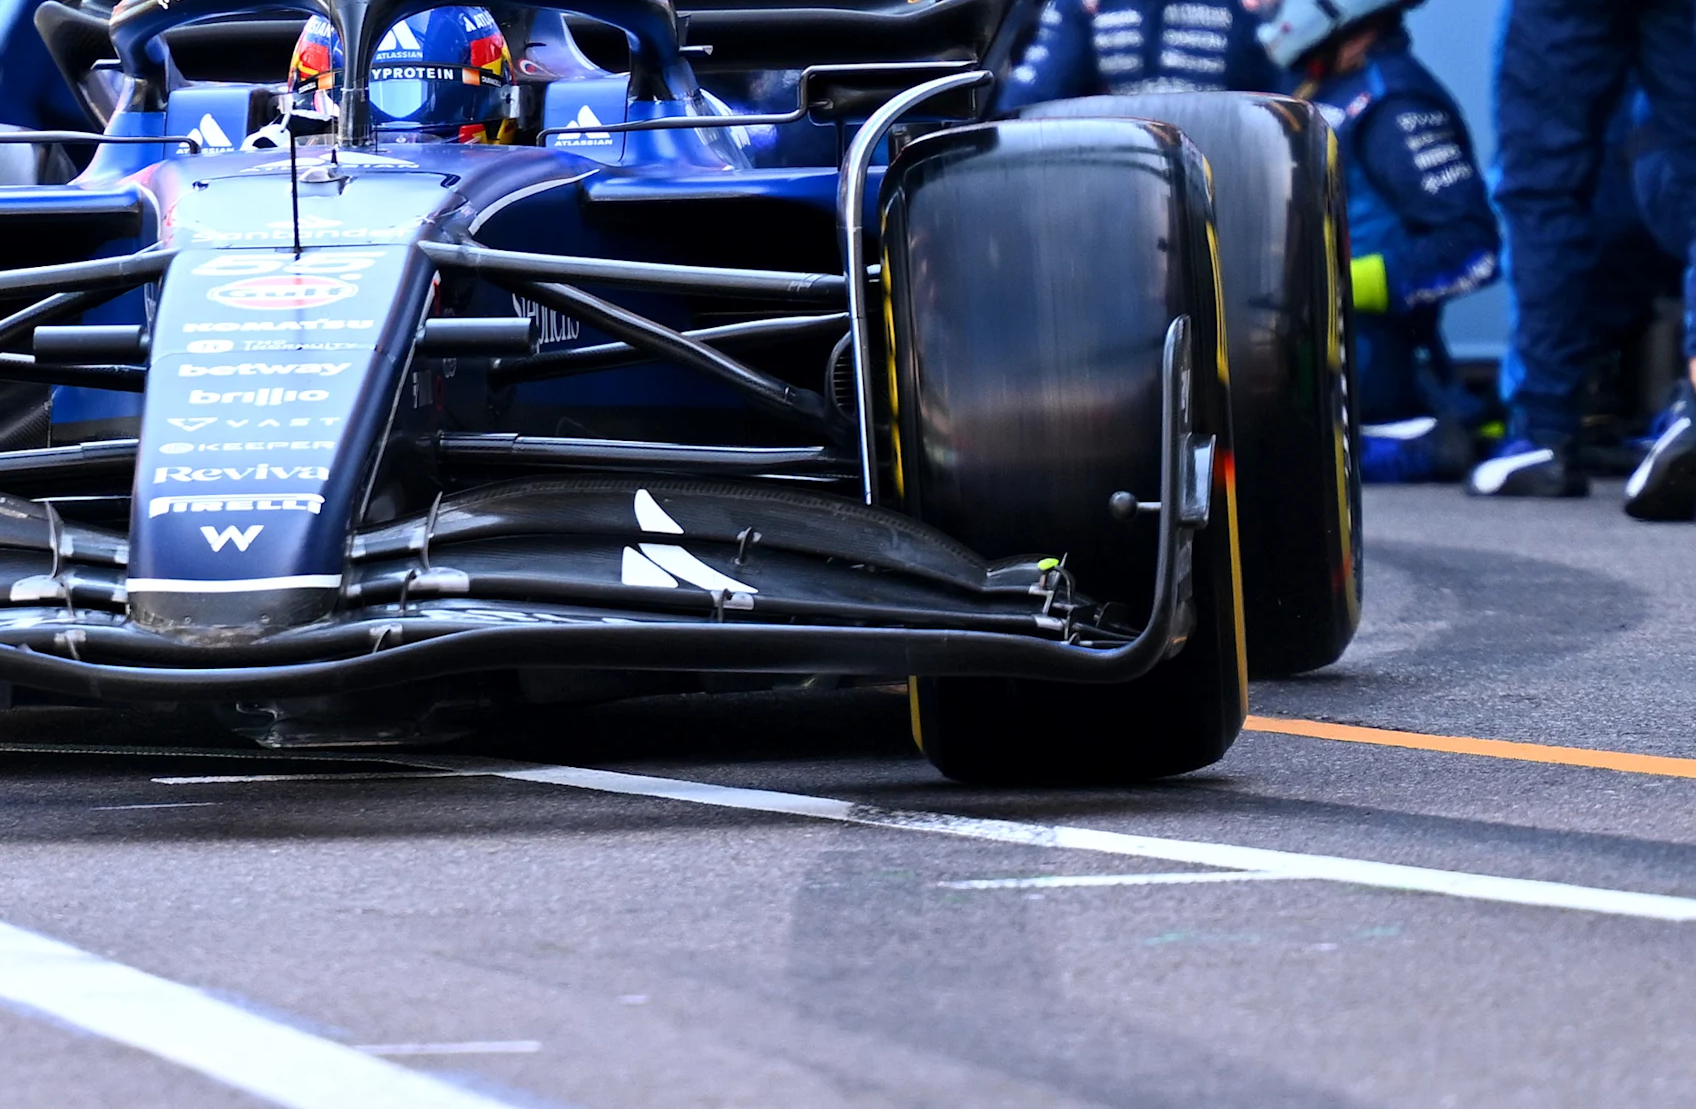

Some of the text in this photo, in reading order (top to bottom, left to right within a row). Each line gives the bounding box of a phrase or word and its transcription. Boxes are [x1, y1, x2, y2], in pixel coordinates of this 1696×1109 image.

[375, 49, 424, 60] ATLASSIAN
[372, 66, 454, 80] YPROTEIN
[554, 138, 613, 147] ATLASSIAN
[190, 226, 416, 243] Santander
[191, 250, 387, 276] 55
[182, 317, 375, 333] KOMATSU
[177, 362, 353, 378] betway
[188, 387, 330, 407] brillio
[226, 417, 342, 428] VAST
[197, 441, 337, 452] KEEPER
[153, 462, 331, 484] Reviva
[148, 492, 326, 519] PIRELLI
